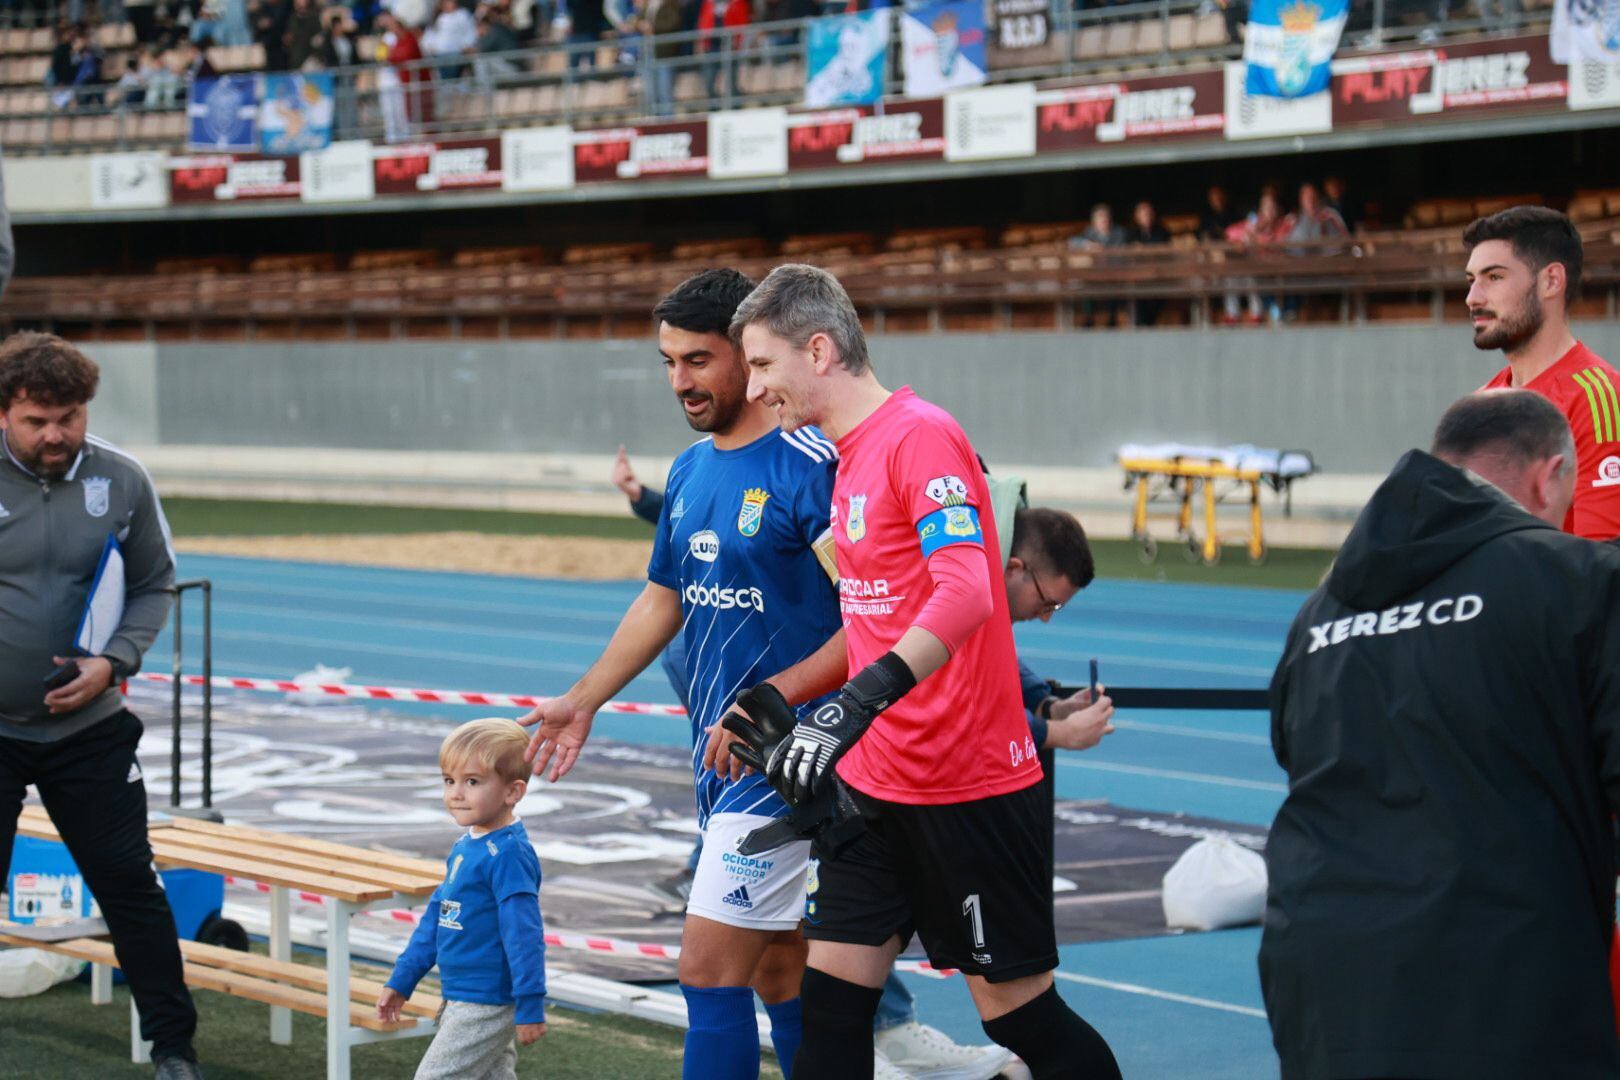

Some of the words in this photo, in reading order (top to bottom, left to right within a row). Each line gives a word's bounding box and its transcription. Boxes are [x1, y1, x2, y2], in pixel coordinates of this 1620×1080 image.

[1307, 601, 1425, 654] XEREZ
[1426, 594, 1484, 625] CD
[1009, 741, 1023, 768] De
[722, 852, 774, 870] OCIOPLAY
[725, 864, 766, 879] INDOOR
[722, 896, 753, 908] adidas
[962, 894, 985, 948] 1
